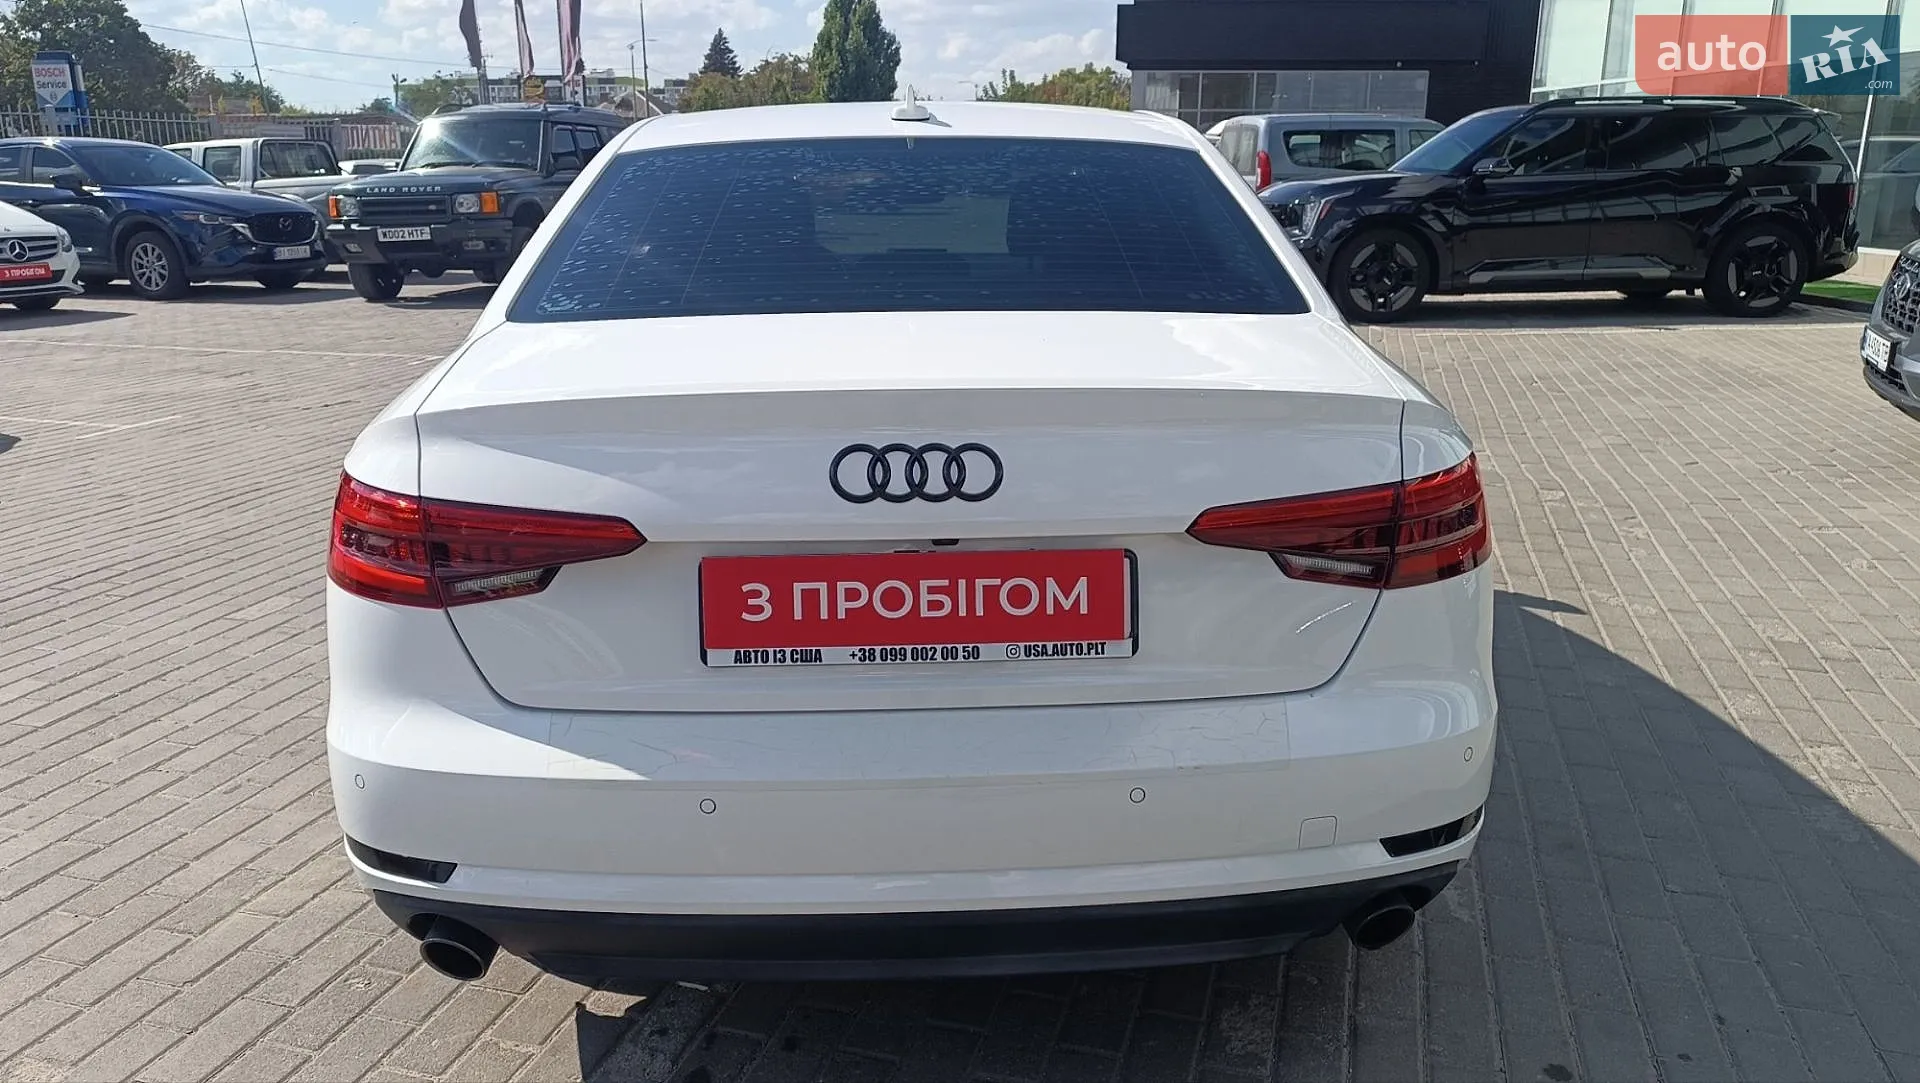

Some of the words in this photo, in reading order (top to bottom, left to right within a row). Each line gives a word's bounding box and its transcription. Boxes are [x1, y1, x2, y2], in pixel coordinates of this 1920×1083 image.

[34, 67, 65, 77] BOSCH
[36, 80, 67, 89] Service
[741, 582, 773, 622] З
[793, 576, 1088, 620] ПРОБІГОМ
[733, 650, 769, 665] АВТО
[772, 649, 787, 664] ІЗ
[789, 648, 823, 664] США
[849, 646, 877, 663] +38
[879, 646, 908, 663] 099
[910, 645, 939, 662] 002
[940, 645, 960, 661] 00
[961, 644, 980, 660] 50
[1023, 641, 1107, 658] USA.AUTO.PLT
